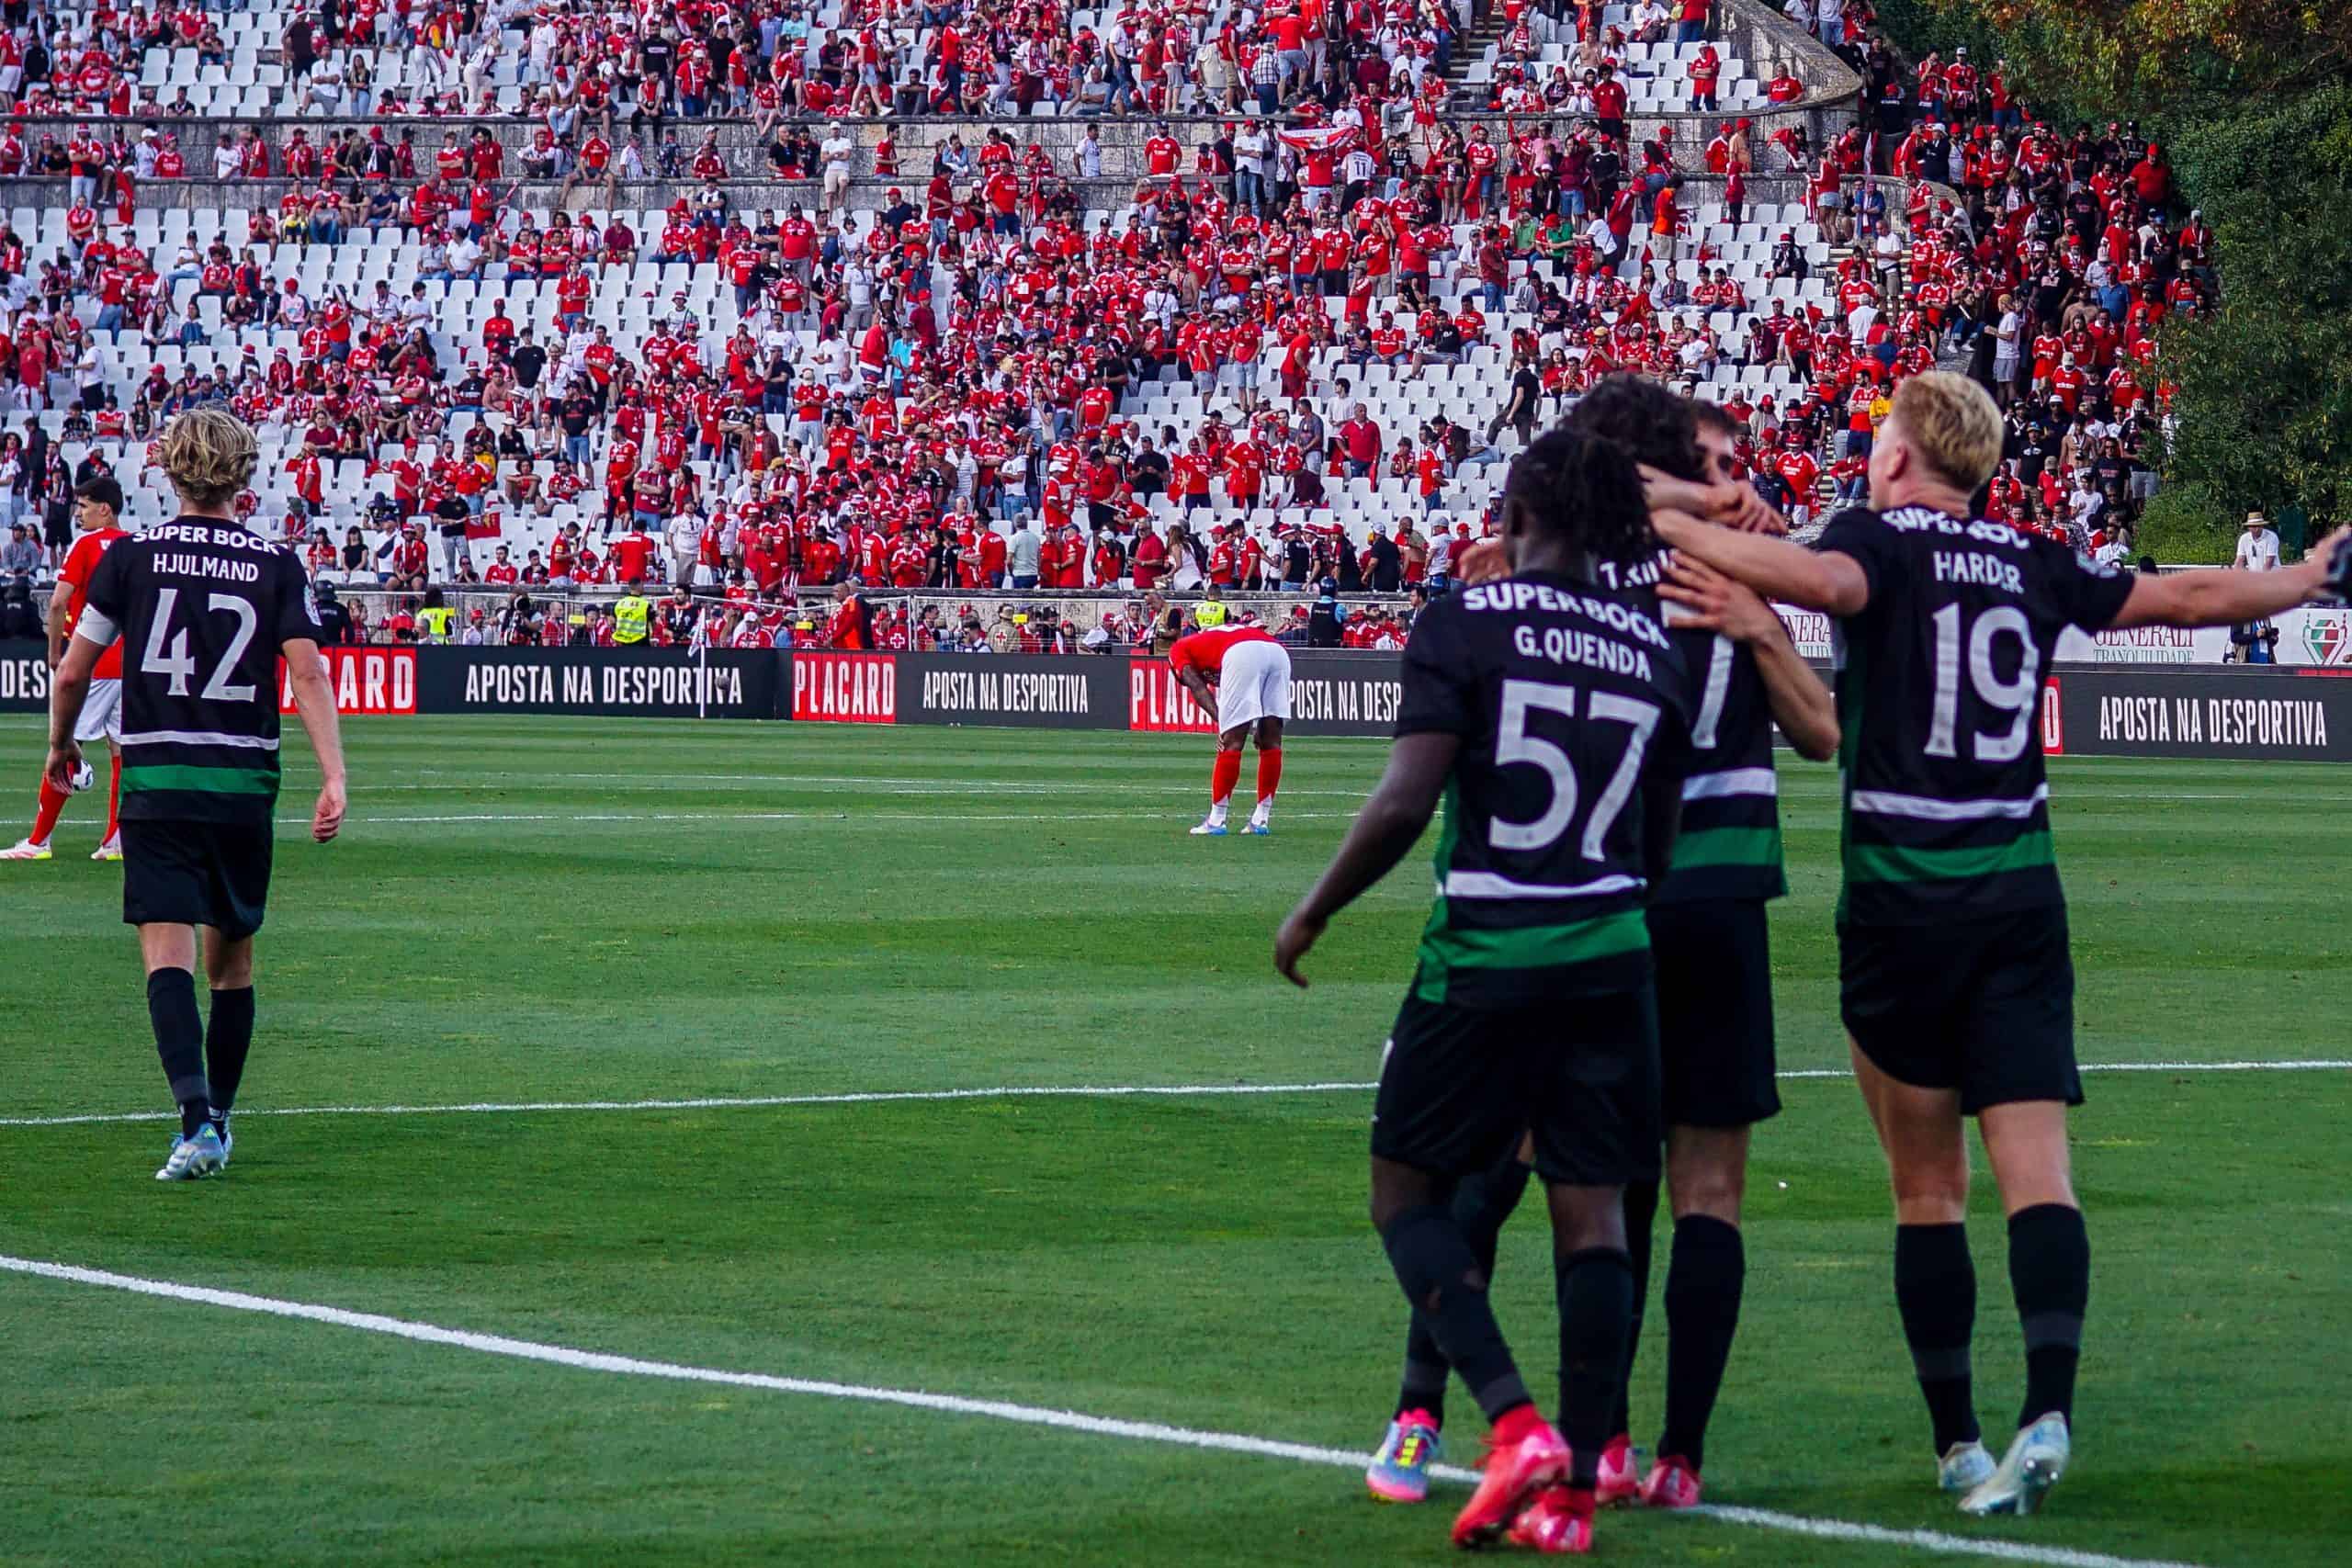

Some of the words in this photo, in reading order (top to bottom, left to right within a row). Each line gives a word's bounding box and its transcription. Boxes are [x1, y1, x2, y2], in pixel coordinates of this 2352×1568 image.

[132, 525, 209, 543] SUPER
[153, 553, 259, 581] HJULMAND
[1463, 582, 1582, 614] SUPER
[141, 588, 257, 702] 42
[1514, 626, 1652, 682] G.QUENDA
[466, 665, 554, 704] APOSTA
[563, 665, 594, 704] NA
[603, 665, 742, 705] DESPORTIVA
[795, 660, 895, 716] PLACARD
[922, 671, 976, 712] APOSTA
[978, 671, 998, 712] NA
[1003, 671, 1089, 714] DESPORTIVA
[1289, 680, 1333, 720] POSTA
[1338, 681, 1358, 721] NA
[1925, 602, 2041, 762] 19
[2099, 695, 2170, 742] APOSTA
[2176, 697, 2202, 743] NA
[2209, 699, 2327, 746] DESPORTIVA
[1488, 678, 1661, 862] 57
